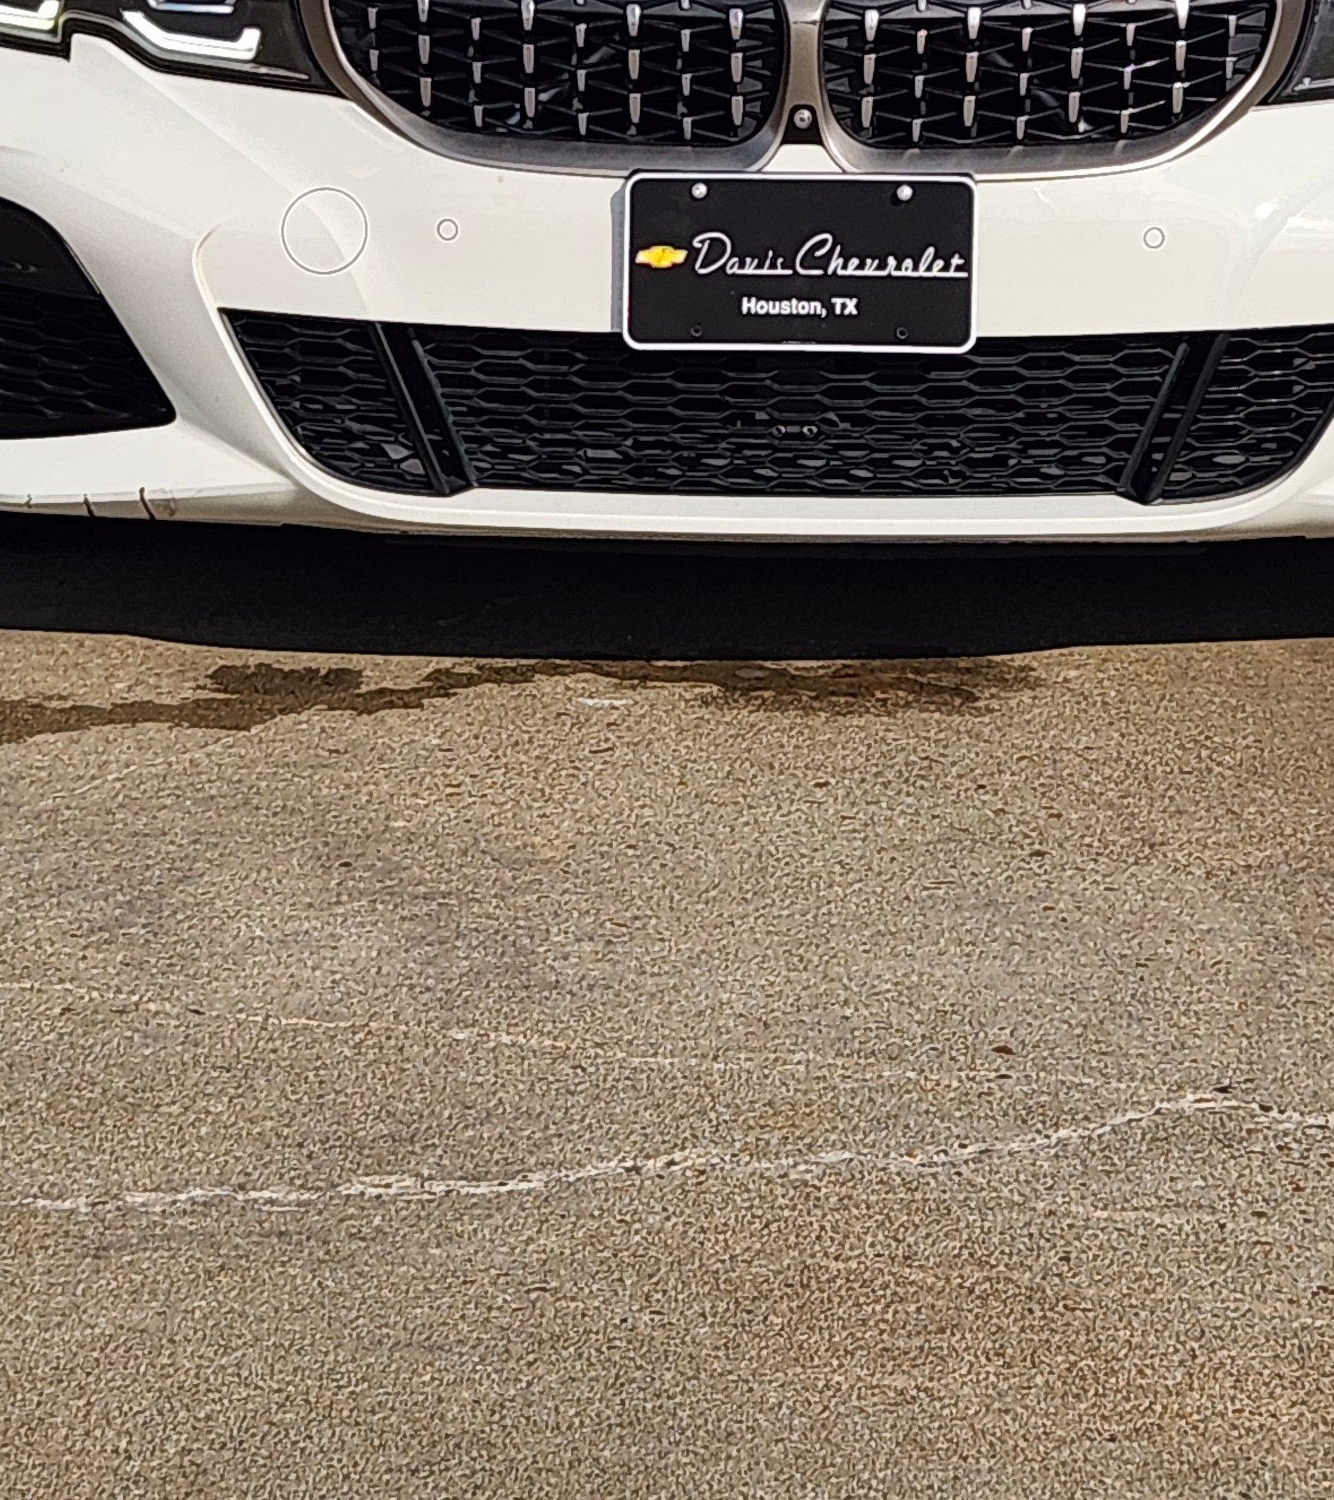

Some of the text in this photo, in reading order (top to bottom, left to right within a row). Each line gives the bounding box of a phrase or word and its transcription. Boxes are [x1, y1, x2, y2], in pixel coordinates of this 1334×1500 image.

[692, 231, 969, 277] Davis Chevrolet
[742, 296, 859, 318] Houston, TX
